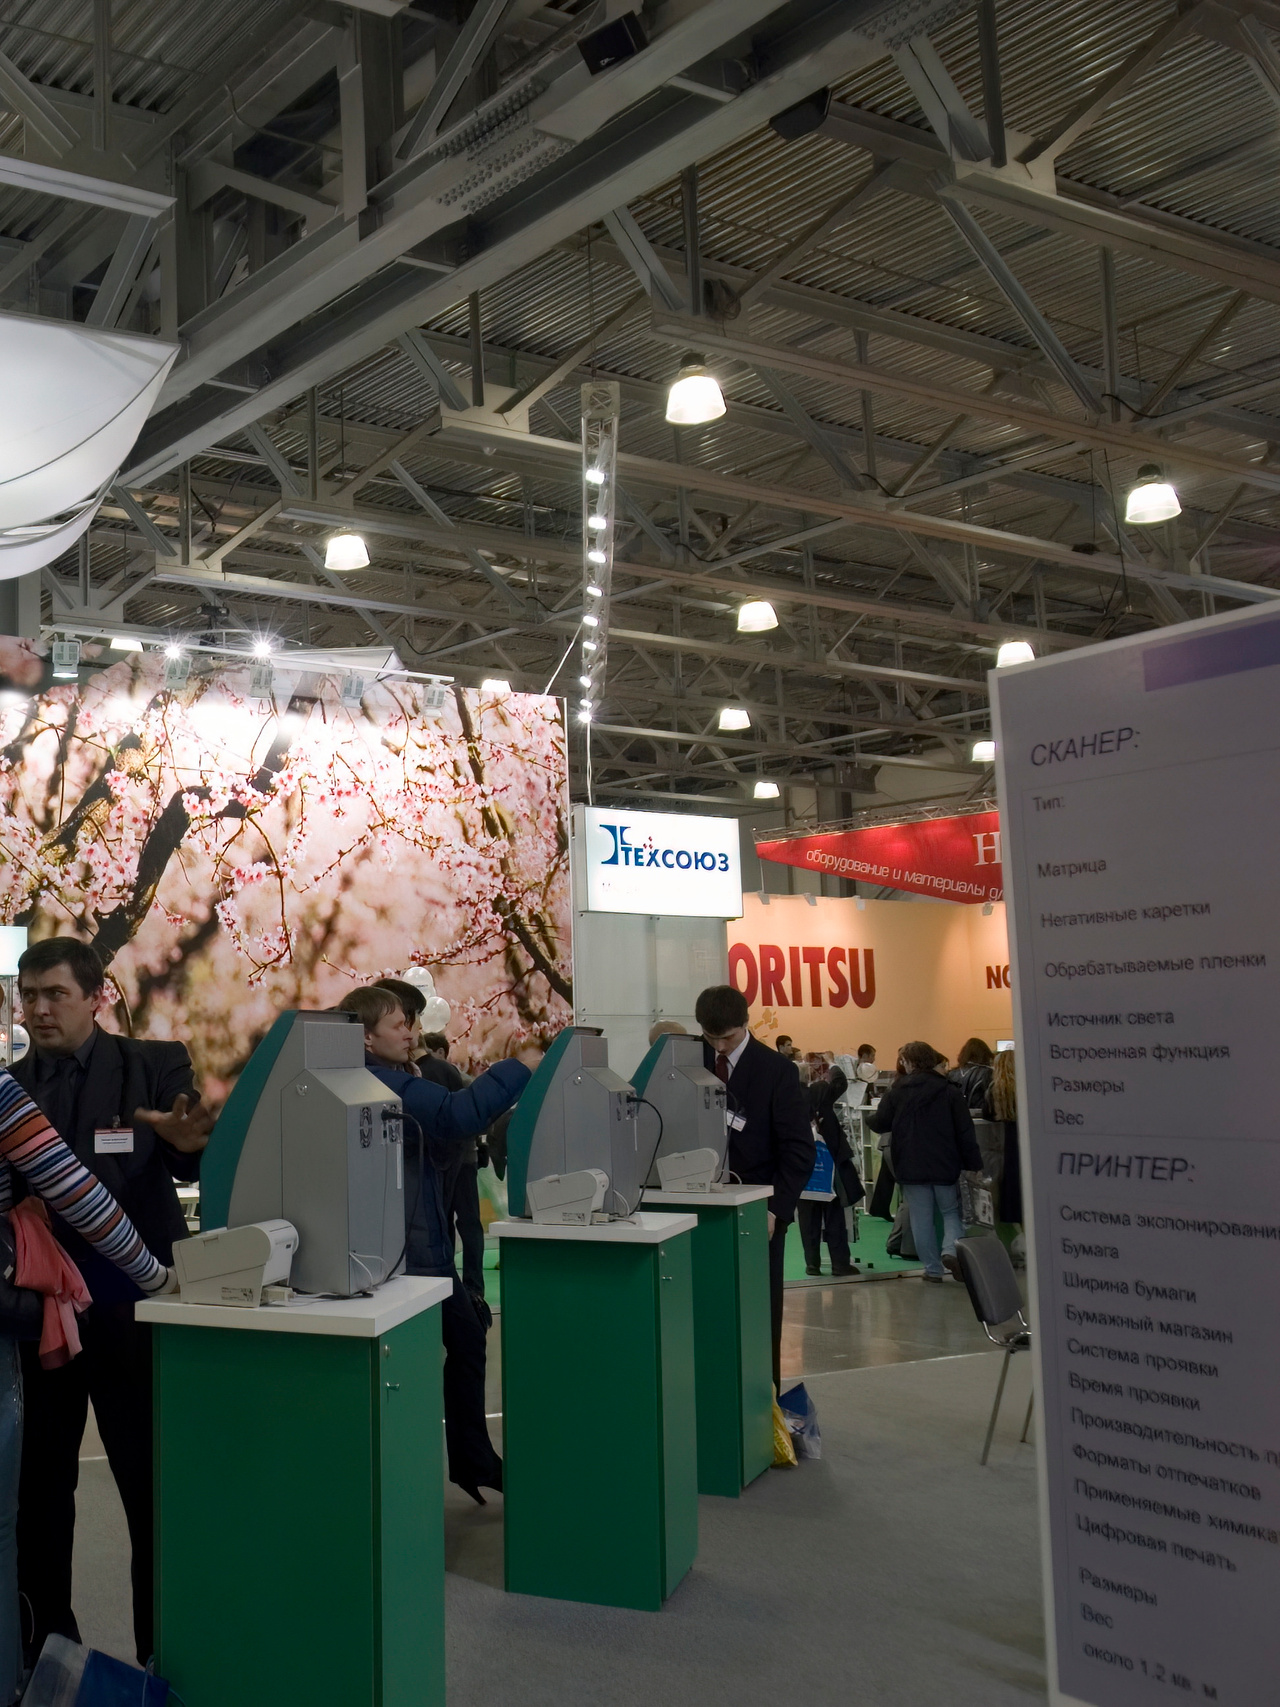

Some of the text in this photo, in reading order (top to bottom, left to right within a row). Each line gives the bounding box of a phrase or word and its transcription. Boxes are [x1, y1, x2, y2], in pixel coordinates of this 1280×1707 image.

[1030, 727, 1141, 767] СКАНЕР:
[621, 846, 730, 872] ТЕХСОЮЗ
[806, 849, 890, 878] оборудование
[892, 867, 901, 880] и
[904, 870, 986, 897] материалы
[1037, 858, 1108, 879] Матрица
[1041, 902, 1212, 928] Негативные каретки
[1045, 953, 1267, 980] Обрабатываемые пленки
[1047, 1011, 1175, 1027] Источник света
[1049, 1043, 1231, 1063] Встроенная функция
[1051, 1076, 1125, 1096] Размеры
[1054, 1109, 1085, 1126] Вес
[1057, 1152, 1195, 1183] ПРИНТЕР:
[1060, 1205, 1280, 1241] Система экспонировани
[1061, 1238, 1120, 1260] Бумага
[1063, 1271, 1197, 1304] Ширина бумаги
[1065, 1304, 1234, 1345] Бумажный магазин
[1067, 1338, 1220, 1379] Система проявки
[1069, 1371, 1202, 1412] Время проявки
[1071, 1406, 1260, 1462] Производительность
[1072, 1444, 1263, 1502] Форматы отпечатков
[1074, 1477, 1280, 1545] Применяемые химика
[1075, 1513, 1238, 1573] Цифровая печать
[1079, 1566, 1158, 1606] Размеры
[1081, 1602, 1114, 1630] Вес
[1083, 1642, 1135, 1672] около
